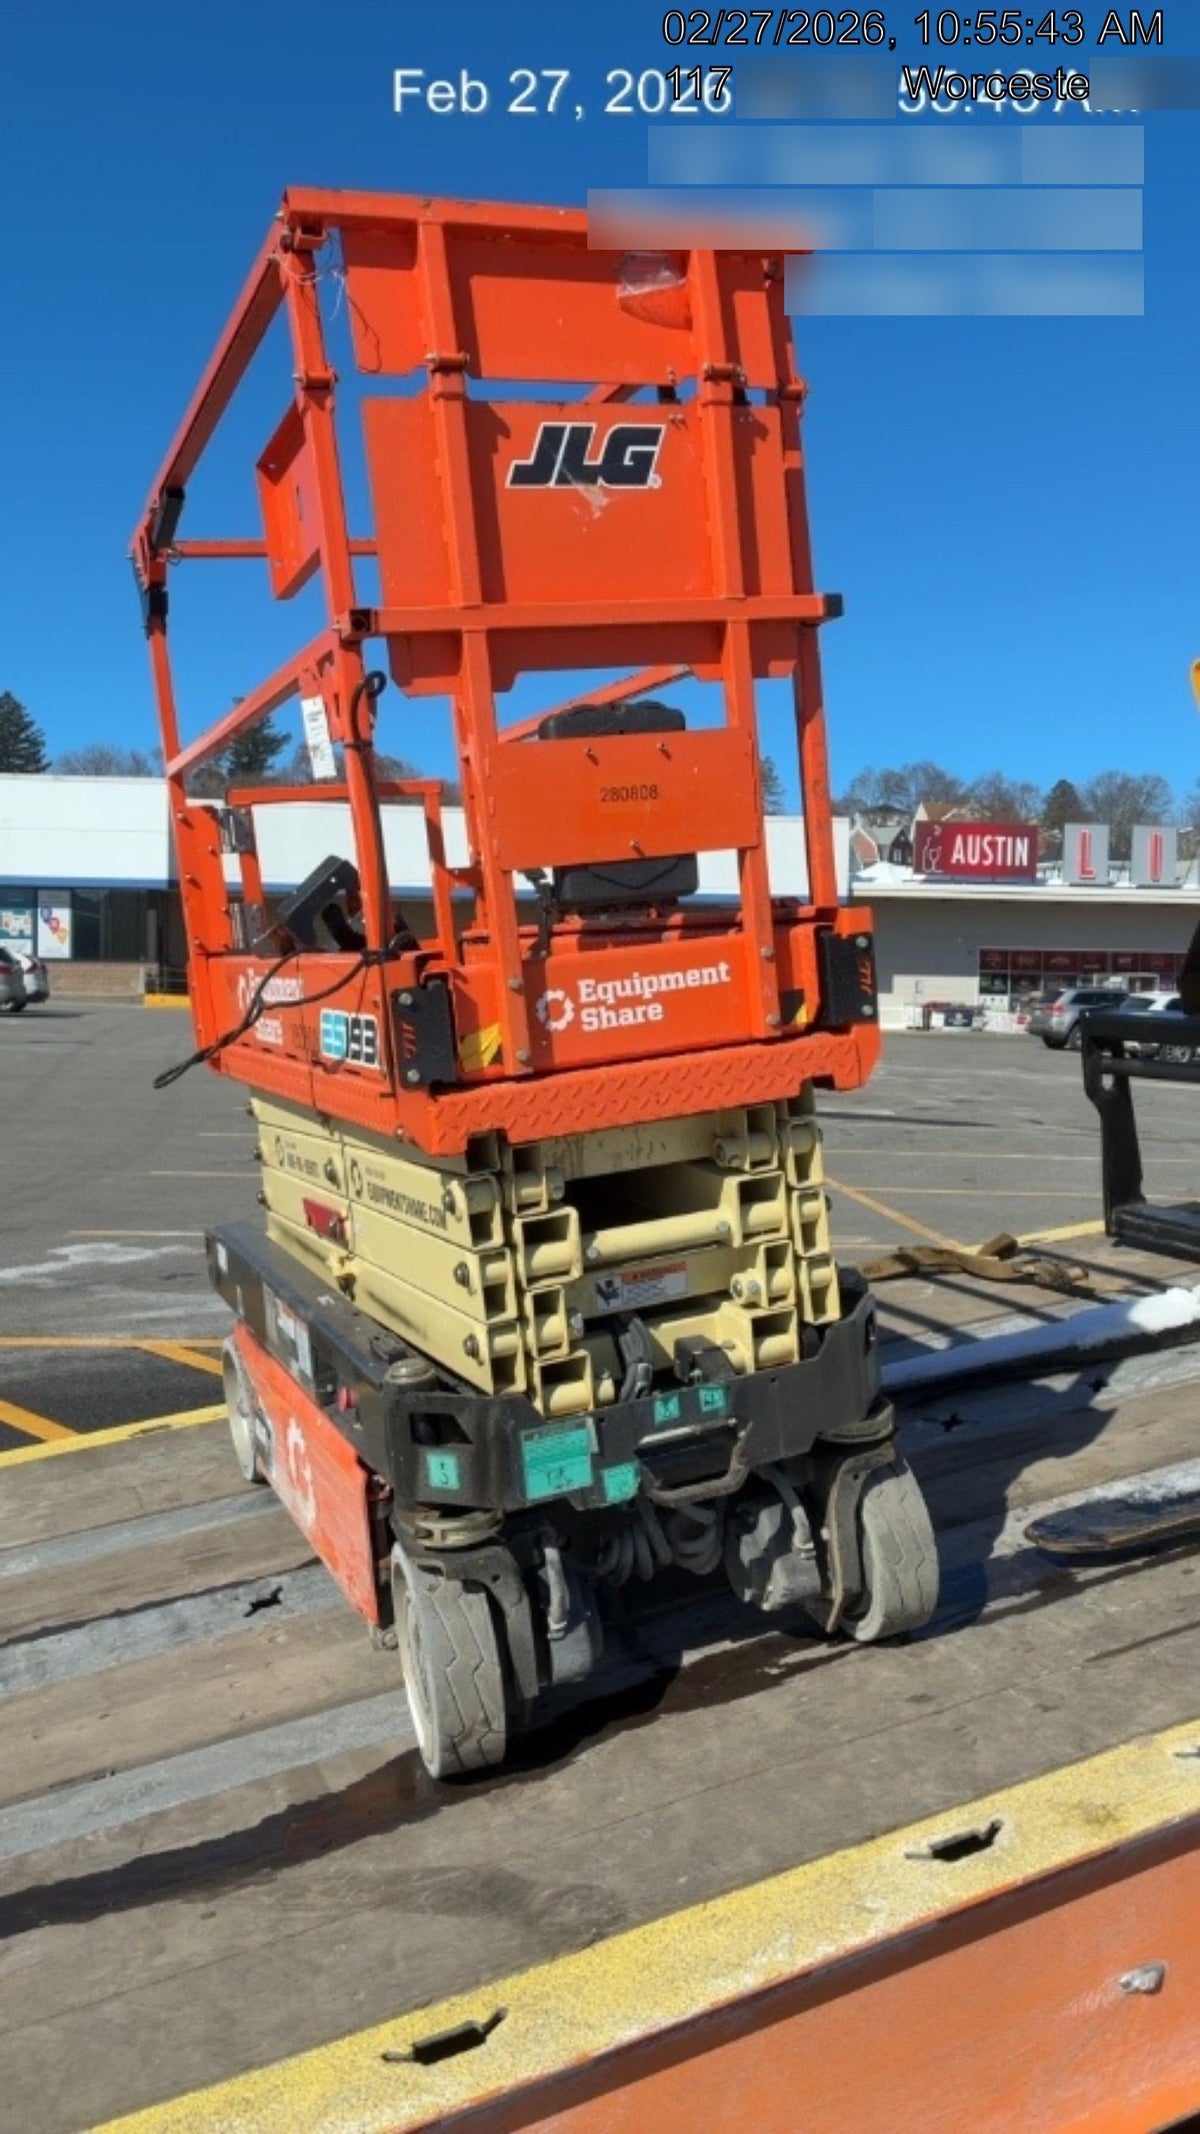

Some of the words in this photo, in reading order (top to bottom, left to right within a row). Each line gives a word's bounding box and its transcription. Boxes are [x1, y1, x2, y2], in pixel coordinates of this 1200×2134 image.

[505, 422, 666, 488] JLG
[950, 834, 1028, 867] AUSTIN
[577, 962, 731, 1004] Equipment
[581, 1003, 663, 1032] Share
